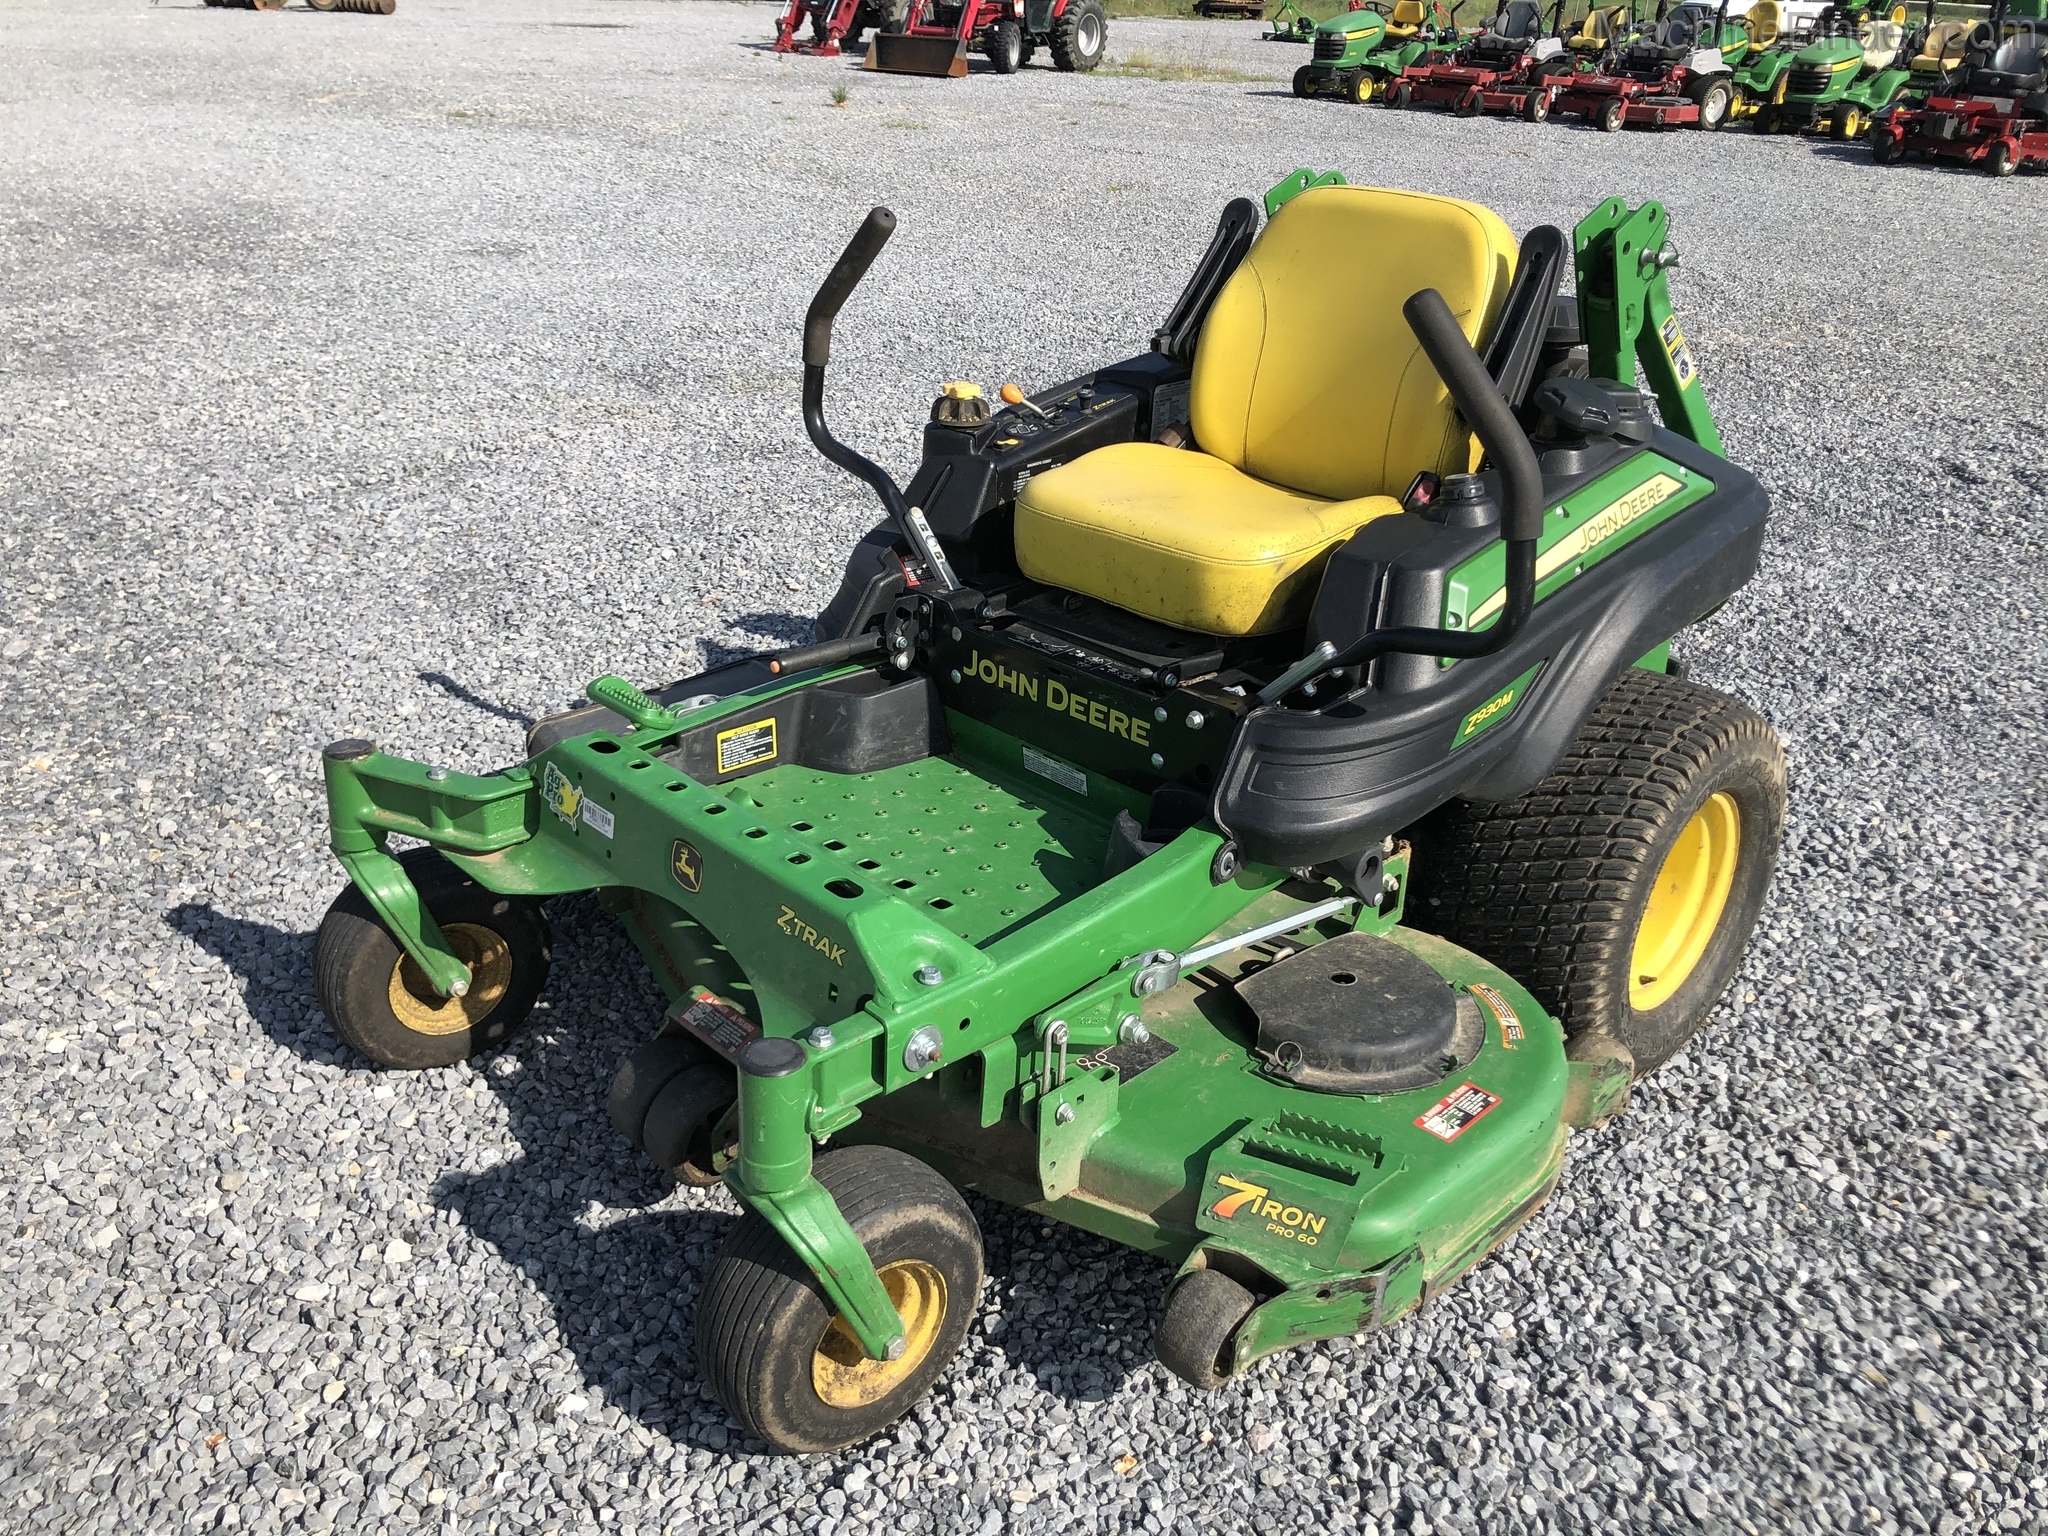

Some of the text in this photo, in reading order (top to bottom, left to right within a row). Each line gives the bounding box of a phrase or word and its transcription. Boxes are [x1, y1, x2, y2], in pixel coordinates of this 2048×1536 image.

[1581, 482, 1664, 550] JOHN DEERE
[963, 650, 1038, 702] JOHN
[1047, 679, 1150, 747] DEERE
[1464, 689, 1514, 735] Z930M
[777, 904, 846, 967] ZTRAK
[1265, 1222, 1318, 1246] PRO 60
